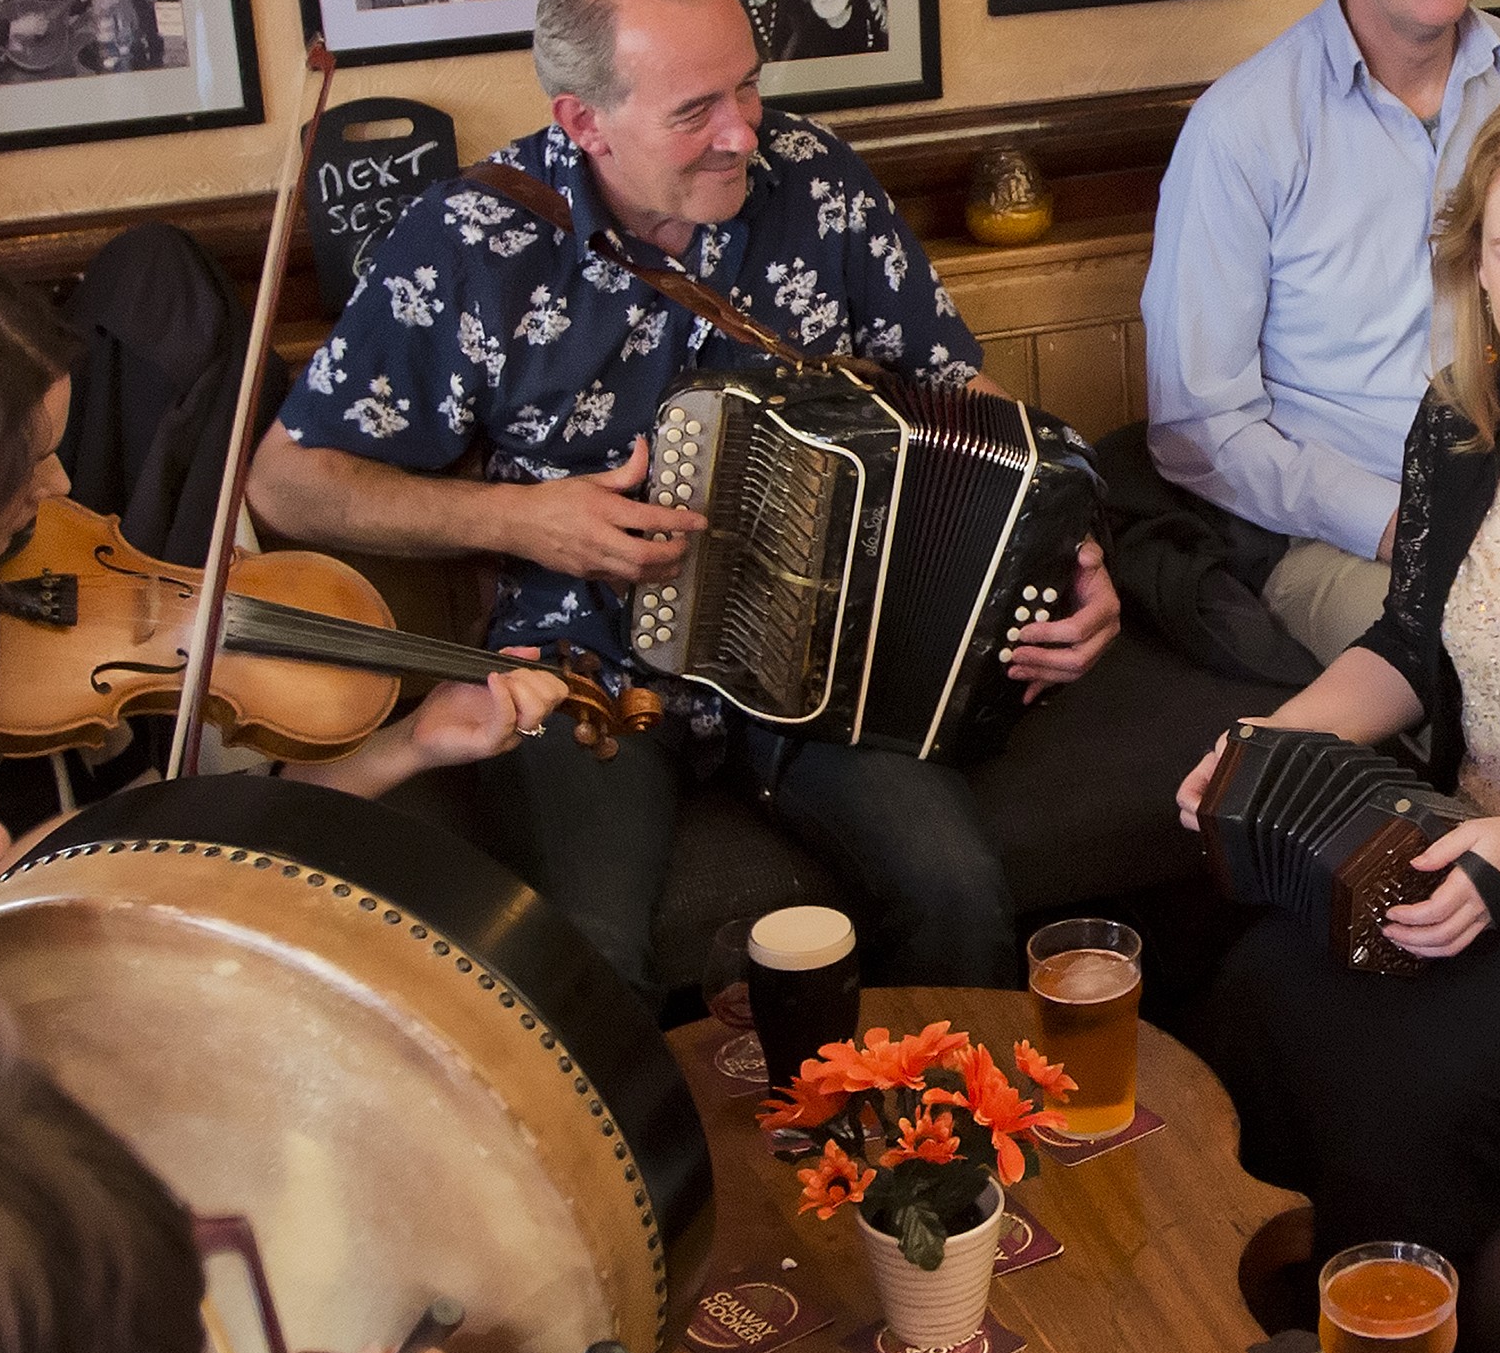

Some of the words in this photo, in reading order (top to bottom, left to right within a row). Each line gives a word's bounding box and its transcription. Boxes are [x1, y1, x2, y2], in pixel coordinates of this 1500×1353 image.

[318, 141, 439, 202] NEXT
[699, 1297, 766, 1345] HOOKER
[713, 1291, 779, 1336] GALWAY
